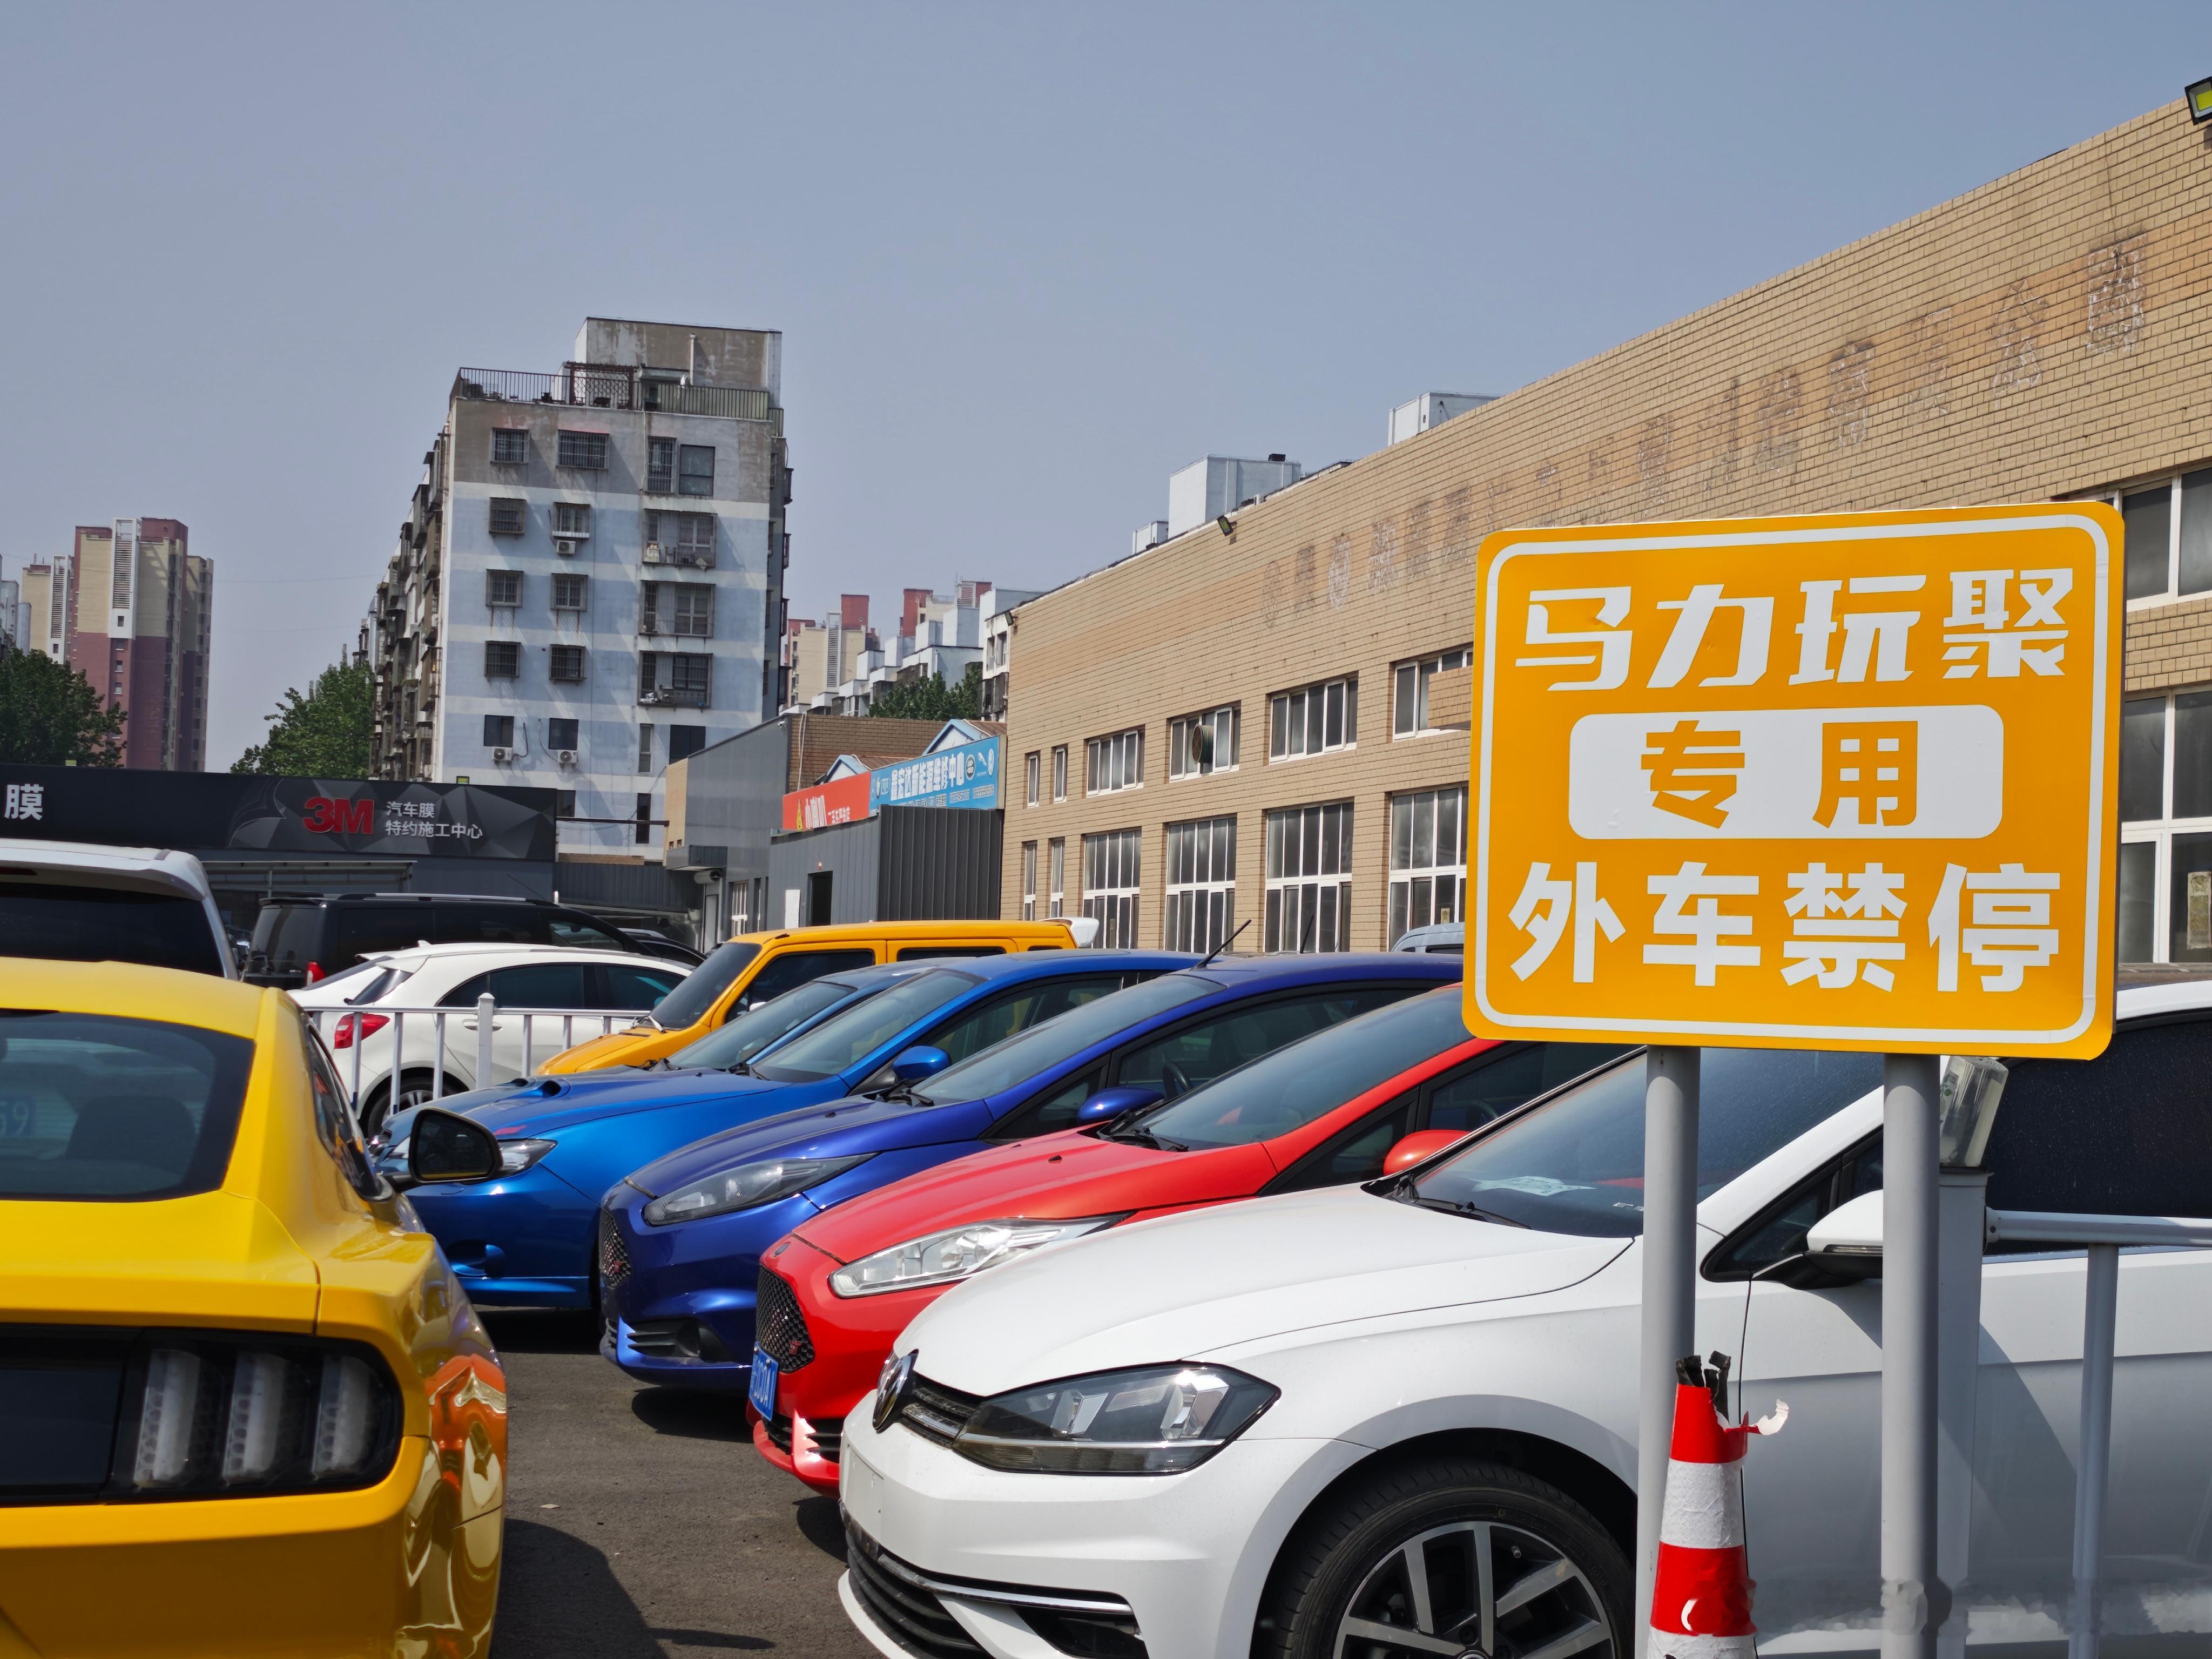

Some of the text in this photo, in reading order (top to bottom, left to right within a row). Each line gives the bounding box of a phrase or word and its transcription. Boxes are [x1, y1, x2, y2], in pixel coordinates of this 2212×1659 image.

[1515, 567, 2074, 692] 马力玩聚
[1640, 720, 1919, 830] 专用
[4, 784, 44, 820] 膜
[303, 797, 375, 834] 3M
[386, 801, 435, 818] 汽车膜
[385, 820, 483, 839] 特约施工中心
[1508, 861, 2061, 993] 外车禁停
